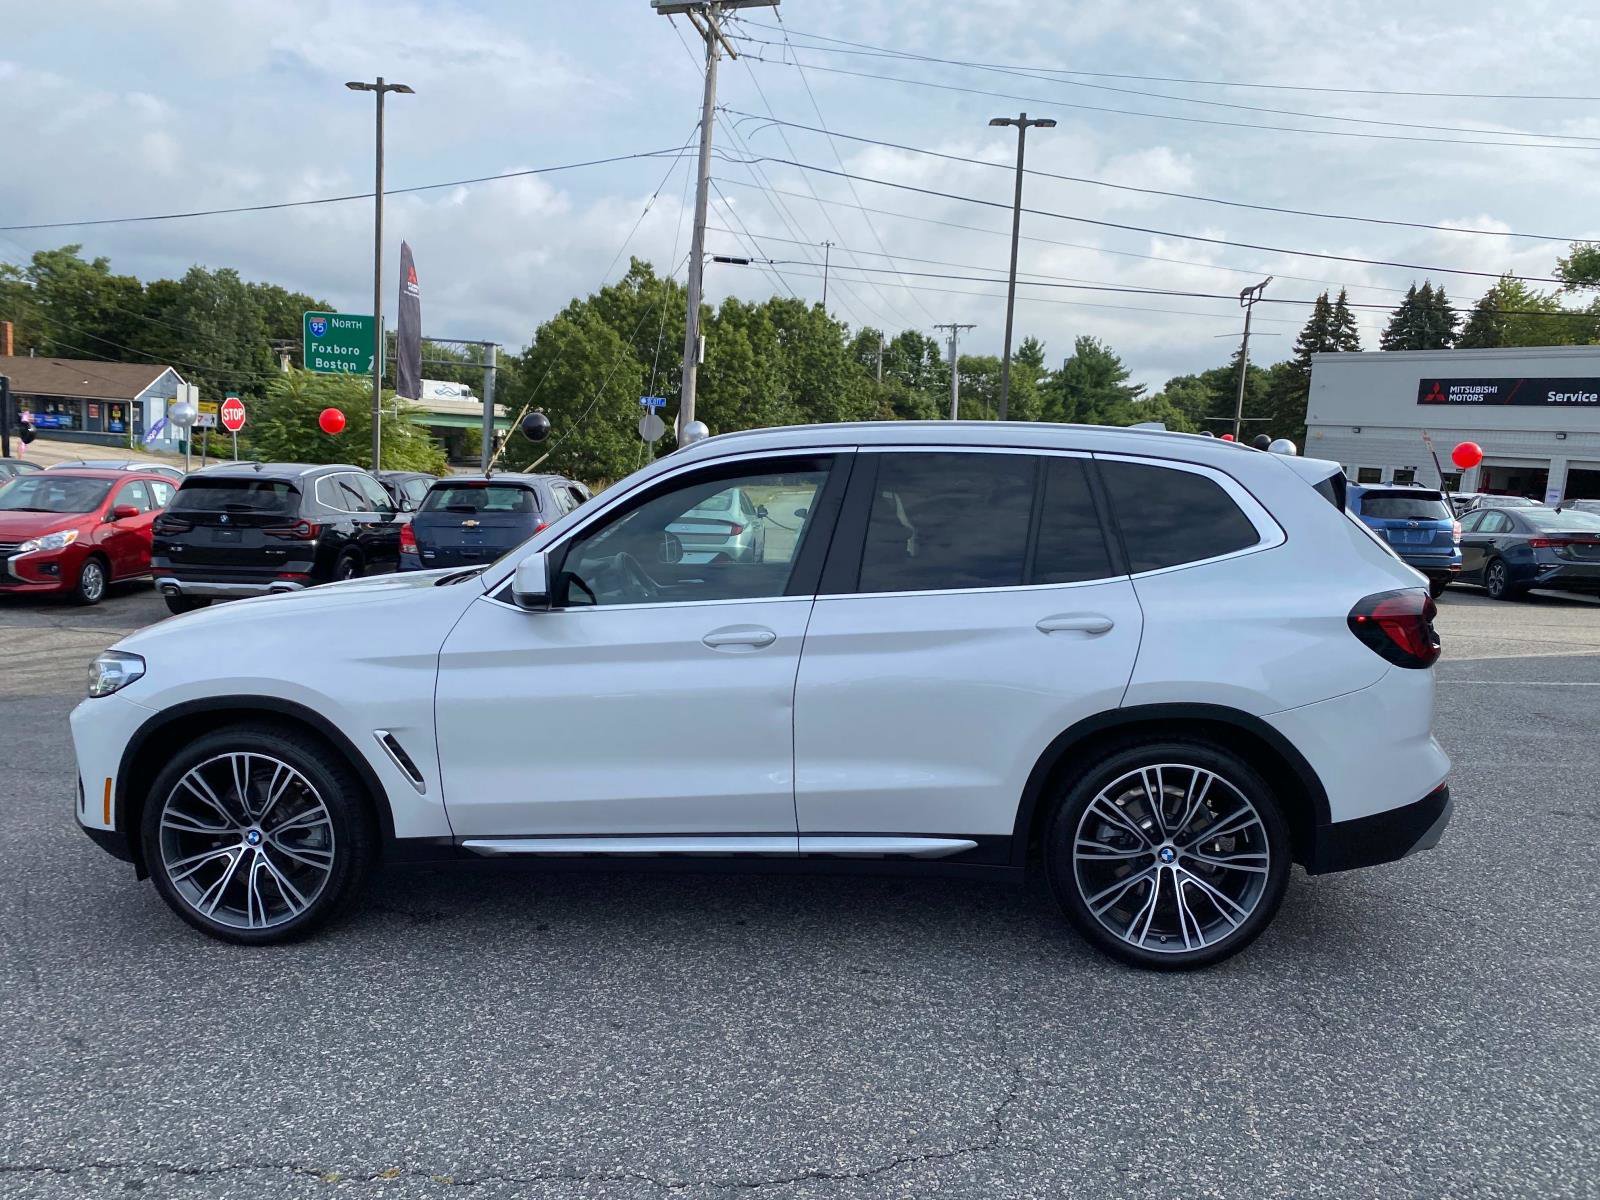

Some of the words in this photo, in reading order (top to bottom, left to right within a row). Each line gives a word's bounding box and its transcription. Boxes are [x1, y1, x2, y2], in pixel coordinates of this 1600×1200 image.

[312, 322, 324, 332] 95
[331, 318, 362, 329] NORTH
[311, 342, 360, 355] Foxboro
[315, 357, 357, 370] Boston
[1449, 385, 1498, 394] MITSUBISHI
[1547, 390, 1598, 402] Service
[1448, 394, 1484, 402] MOTORS
[223, 408, 244, 421] STOP
